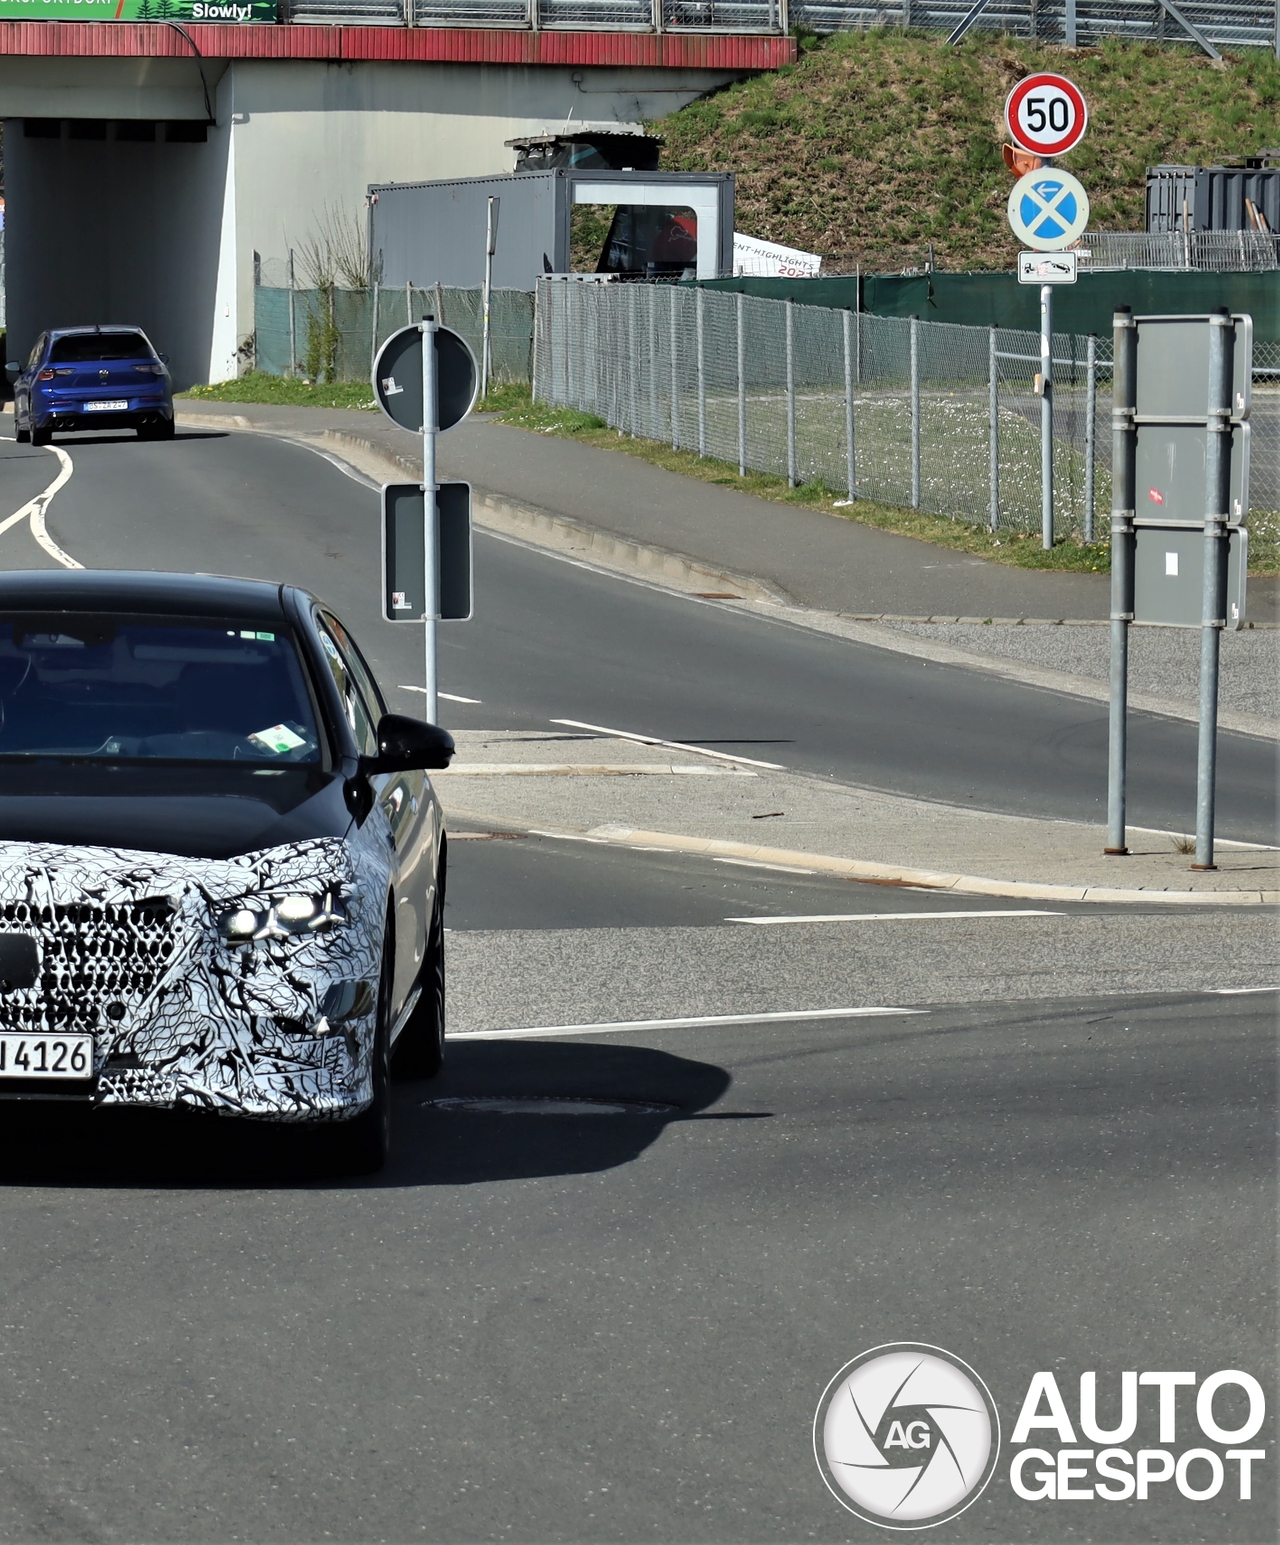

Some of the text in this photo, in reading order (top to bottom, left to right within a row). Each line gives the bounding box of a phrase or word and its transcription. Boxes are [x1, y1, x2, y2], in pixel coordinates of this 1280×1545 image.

[192, 3, 252, 21] Slowly!
[1027, 97, 1068, 132] 50
[14, 1040, 87, 1072] 4126
